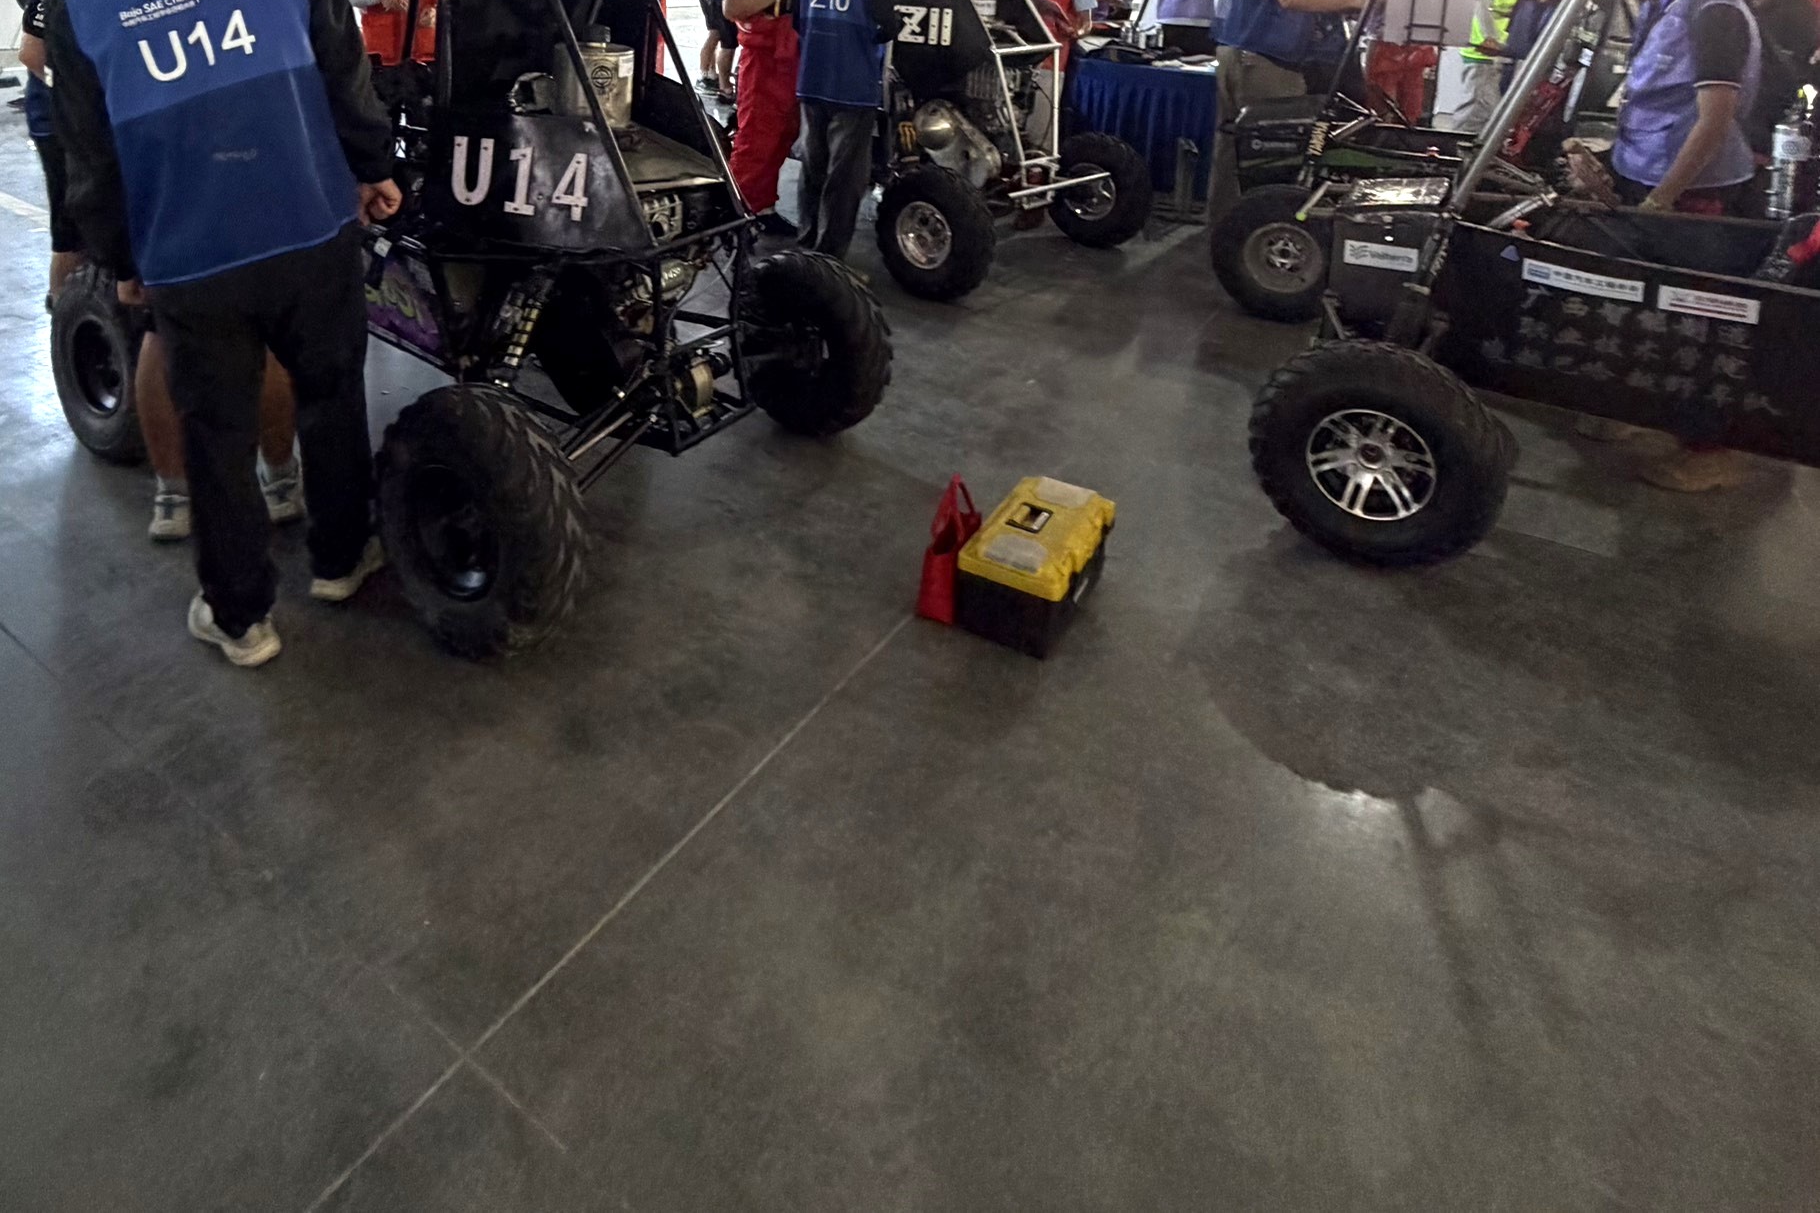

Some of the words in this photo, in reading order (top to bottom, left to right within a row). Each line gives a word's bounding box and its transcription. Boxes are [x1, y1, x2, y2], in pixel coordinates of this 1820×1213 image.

[118, 6, 143, 21] Baja
[893, 5, 953, 46] Z11
[137, 9, 257, 82] U14
[451, 135, 589, 222] U14
